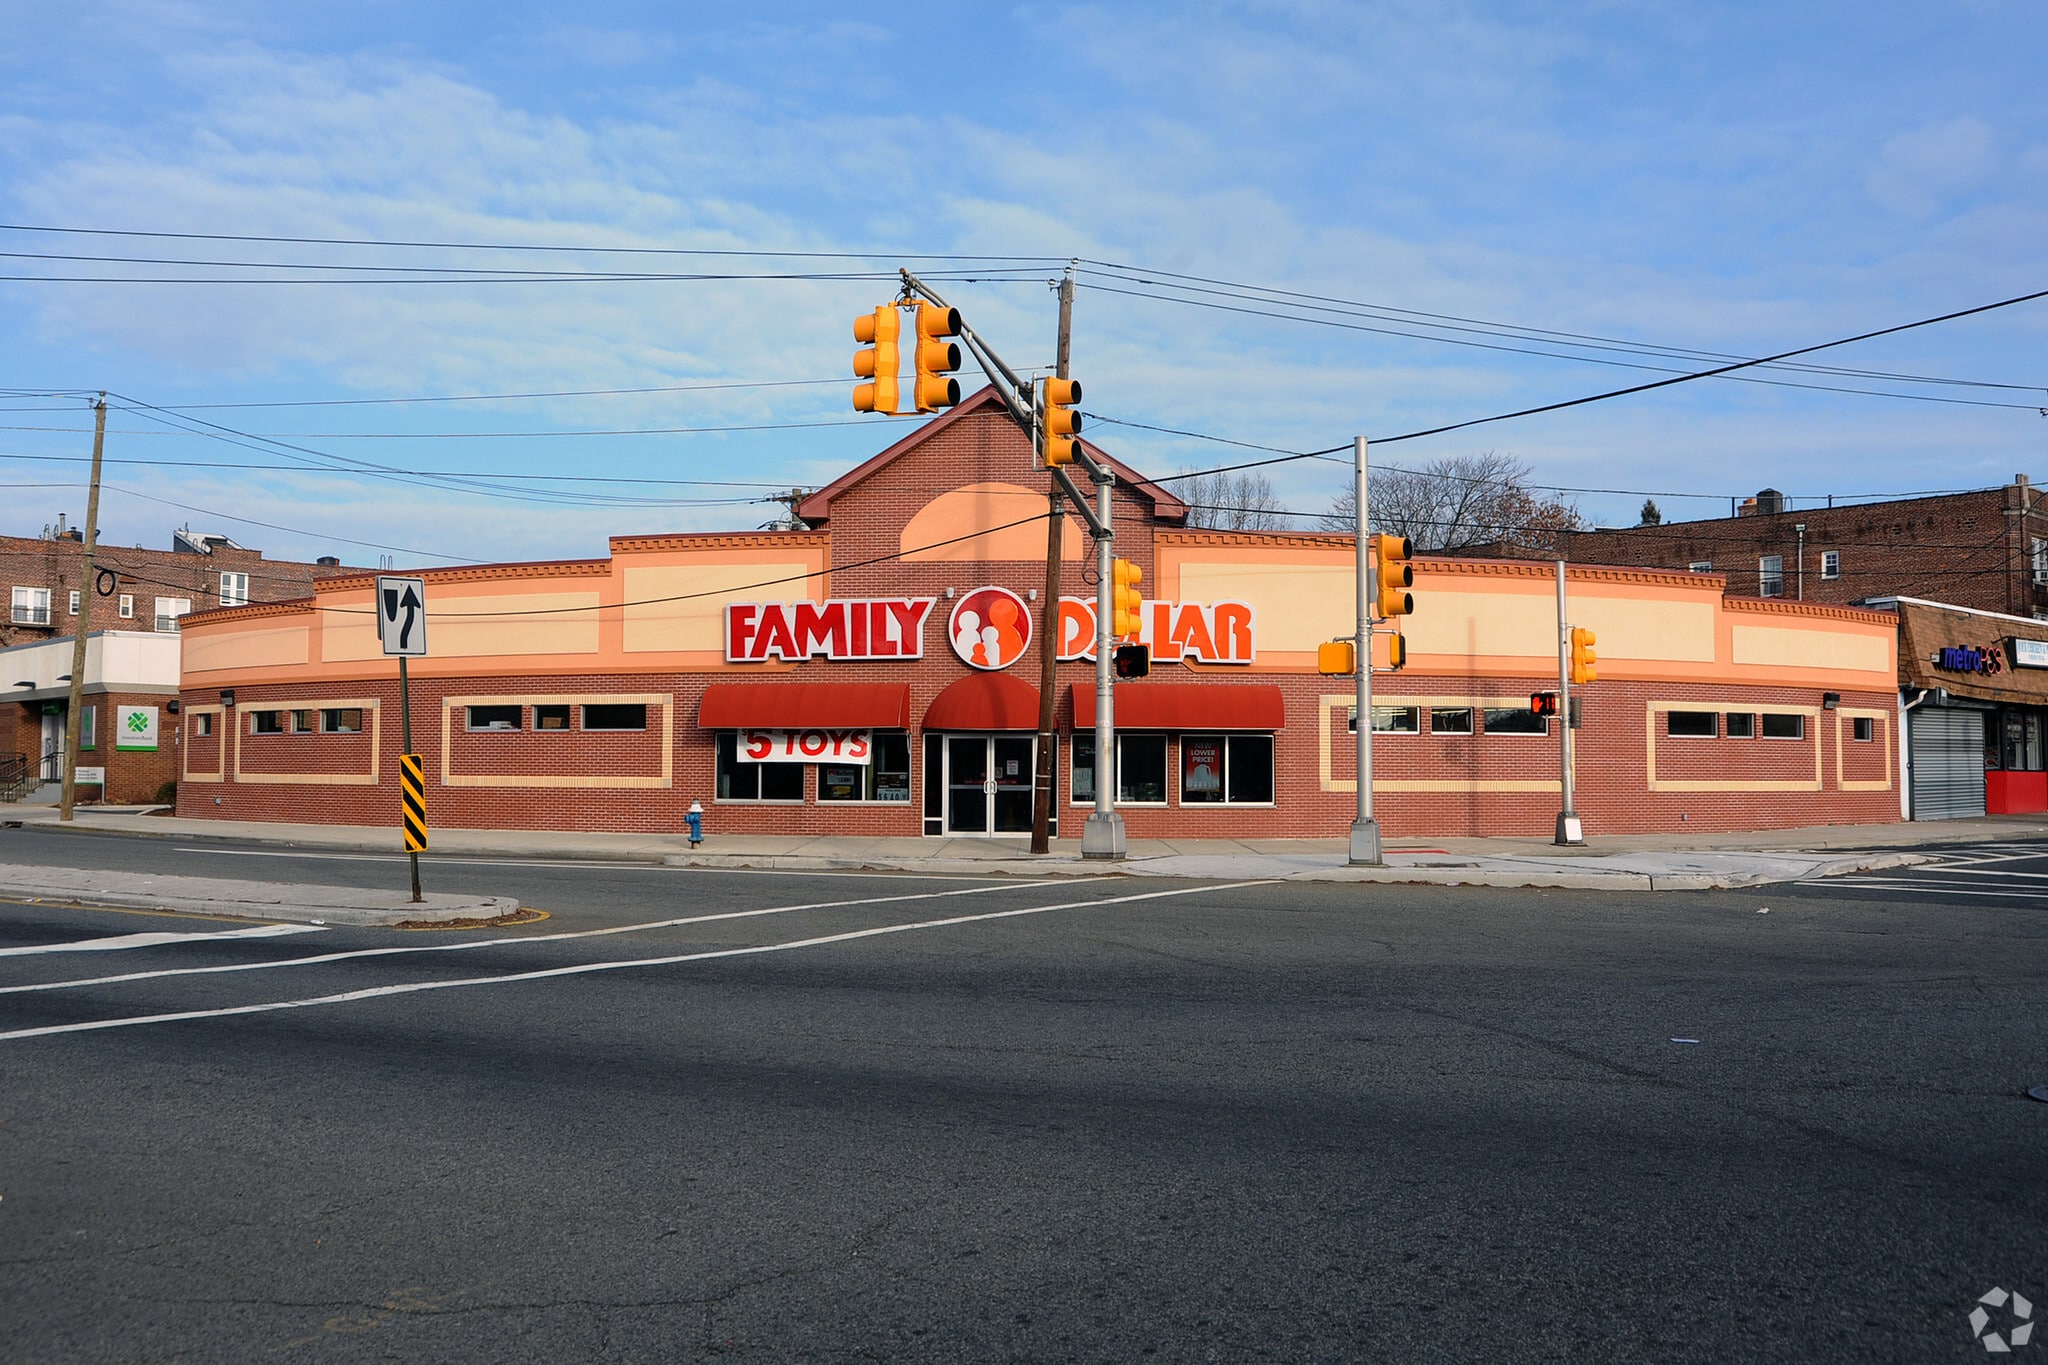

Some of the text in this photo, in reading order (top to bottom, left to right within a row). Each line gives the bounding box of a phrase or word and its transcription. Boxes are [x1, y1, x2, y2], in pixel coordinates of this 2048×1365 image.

[729, 600, 1253, 661] FAMILY DLAR
[1944, 644, 2002, 675] metroPCS
[782, 728, 869, 757] TOYS
[1190, 749, 1216, 757] LOWER
